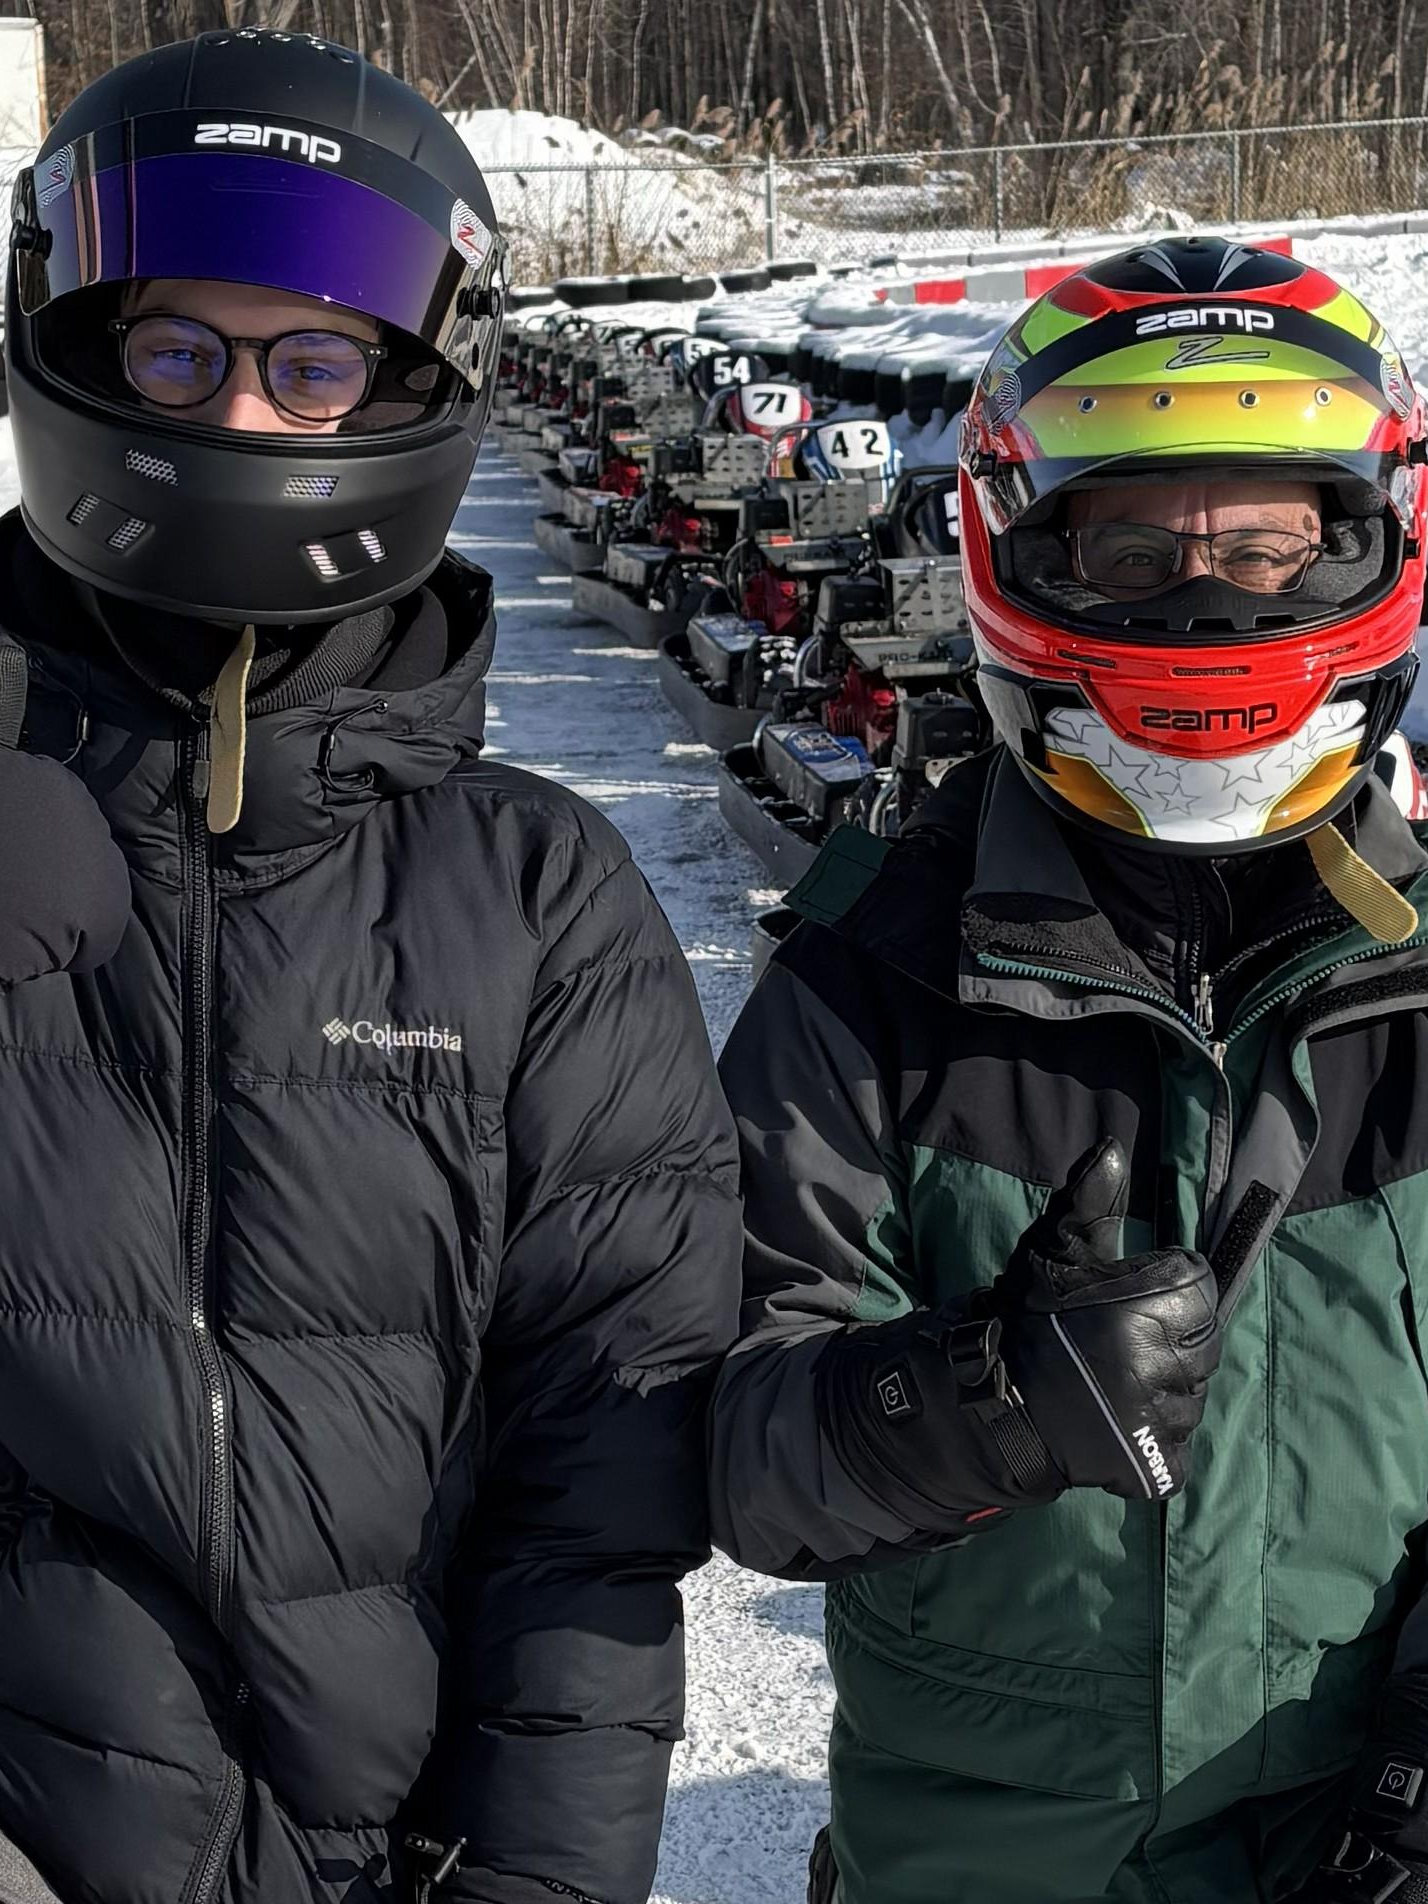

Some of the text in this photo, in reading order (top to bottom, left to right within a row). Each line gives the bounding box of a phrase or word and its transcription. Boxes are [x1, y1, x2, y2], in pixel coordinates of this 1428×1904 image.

[193, 122, 342, 165] zamp
[1135, 307, 1275, 335] zamp
[713, 356, 751, 385] 54
[752, 392, 787, 414] 71
[1140, 702, 1279, 734] zamp
[352, 1021, 463, 1053] Columbia
[1132, 1424, 1173, 1496] KARBON
